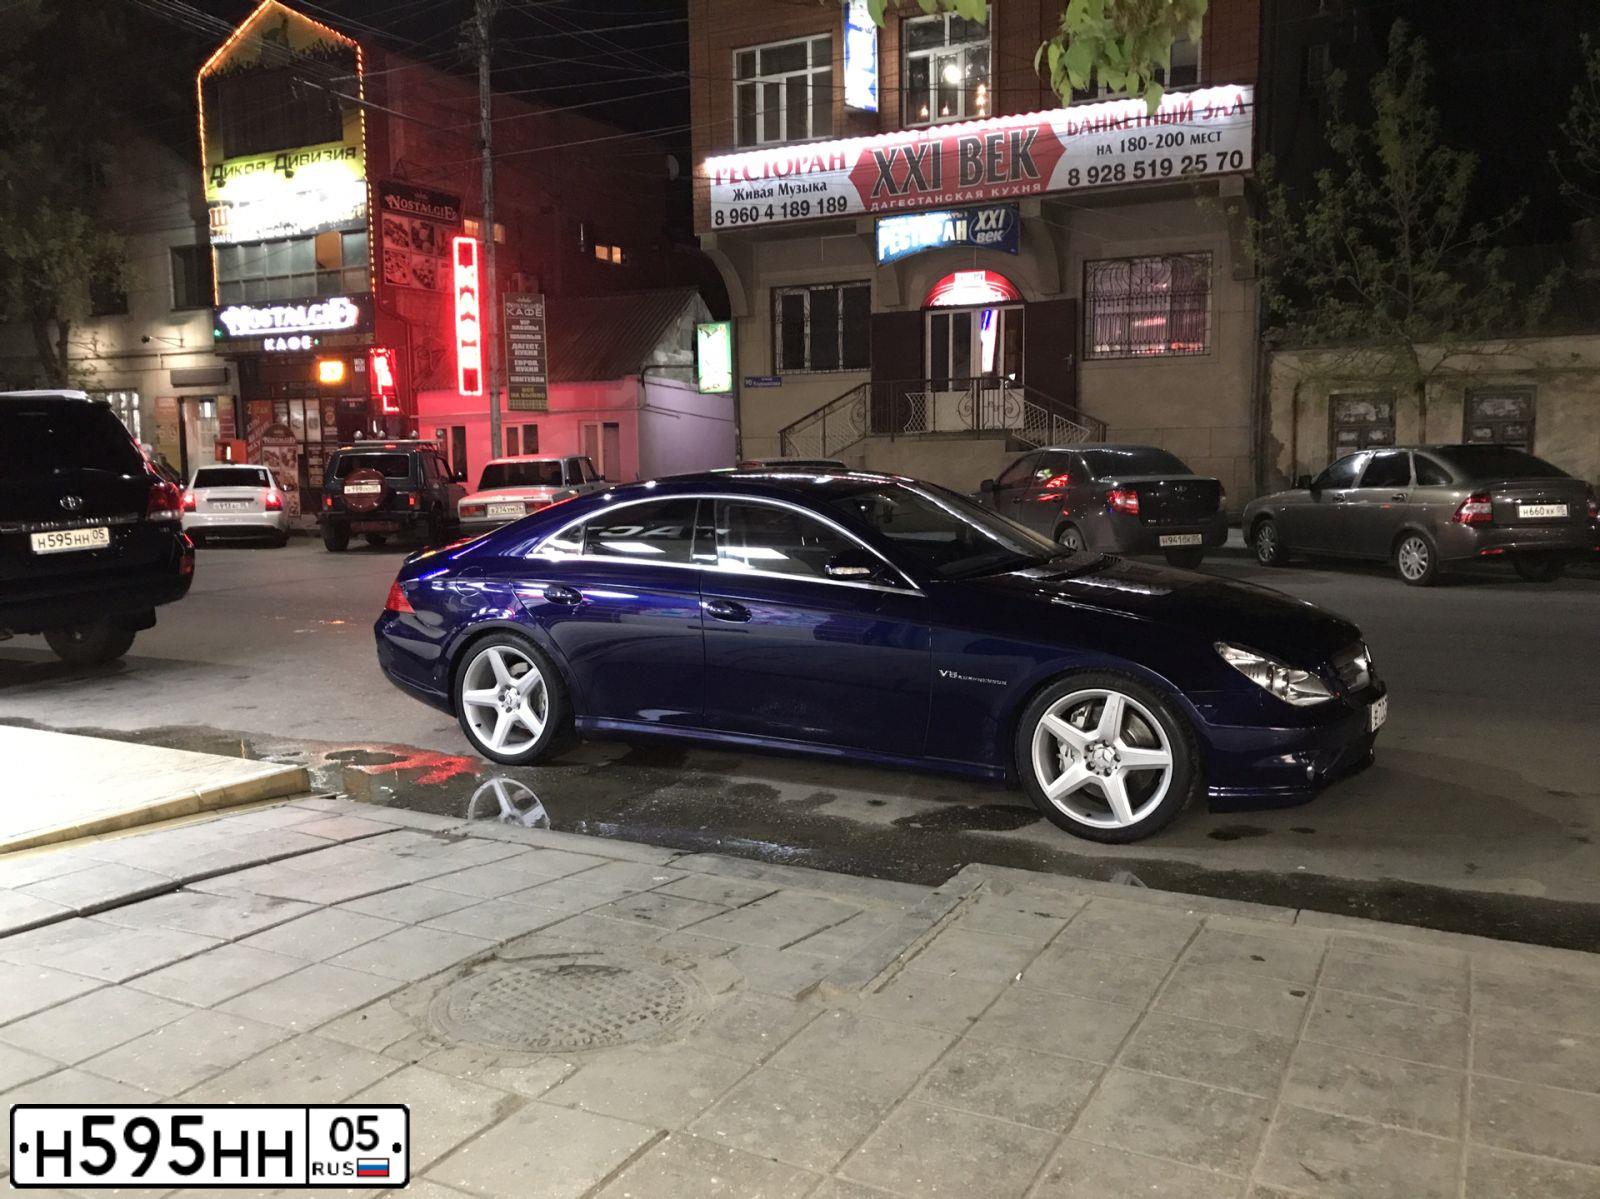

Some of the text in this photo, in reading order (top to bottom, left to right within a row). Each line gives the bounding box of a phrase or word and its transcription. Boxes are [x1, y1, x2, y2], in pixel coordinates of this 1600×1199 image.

[957, 126, 1041, 189] ВЕК
[1096, 131, 1223, 156] НА 180-200 МЕСТ
[1068, 150, 1244, 186] 8 928 519 25 70
[732, 181, 828, 202] Живая Музыка
[870, 183, 1042, 212] ДАГЕСТАНСКАЯ КУХНЯ
[715, 196, 848, 226] 8 960 4 189 189
[92, 529, 105, 541] 05
